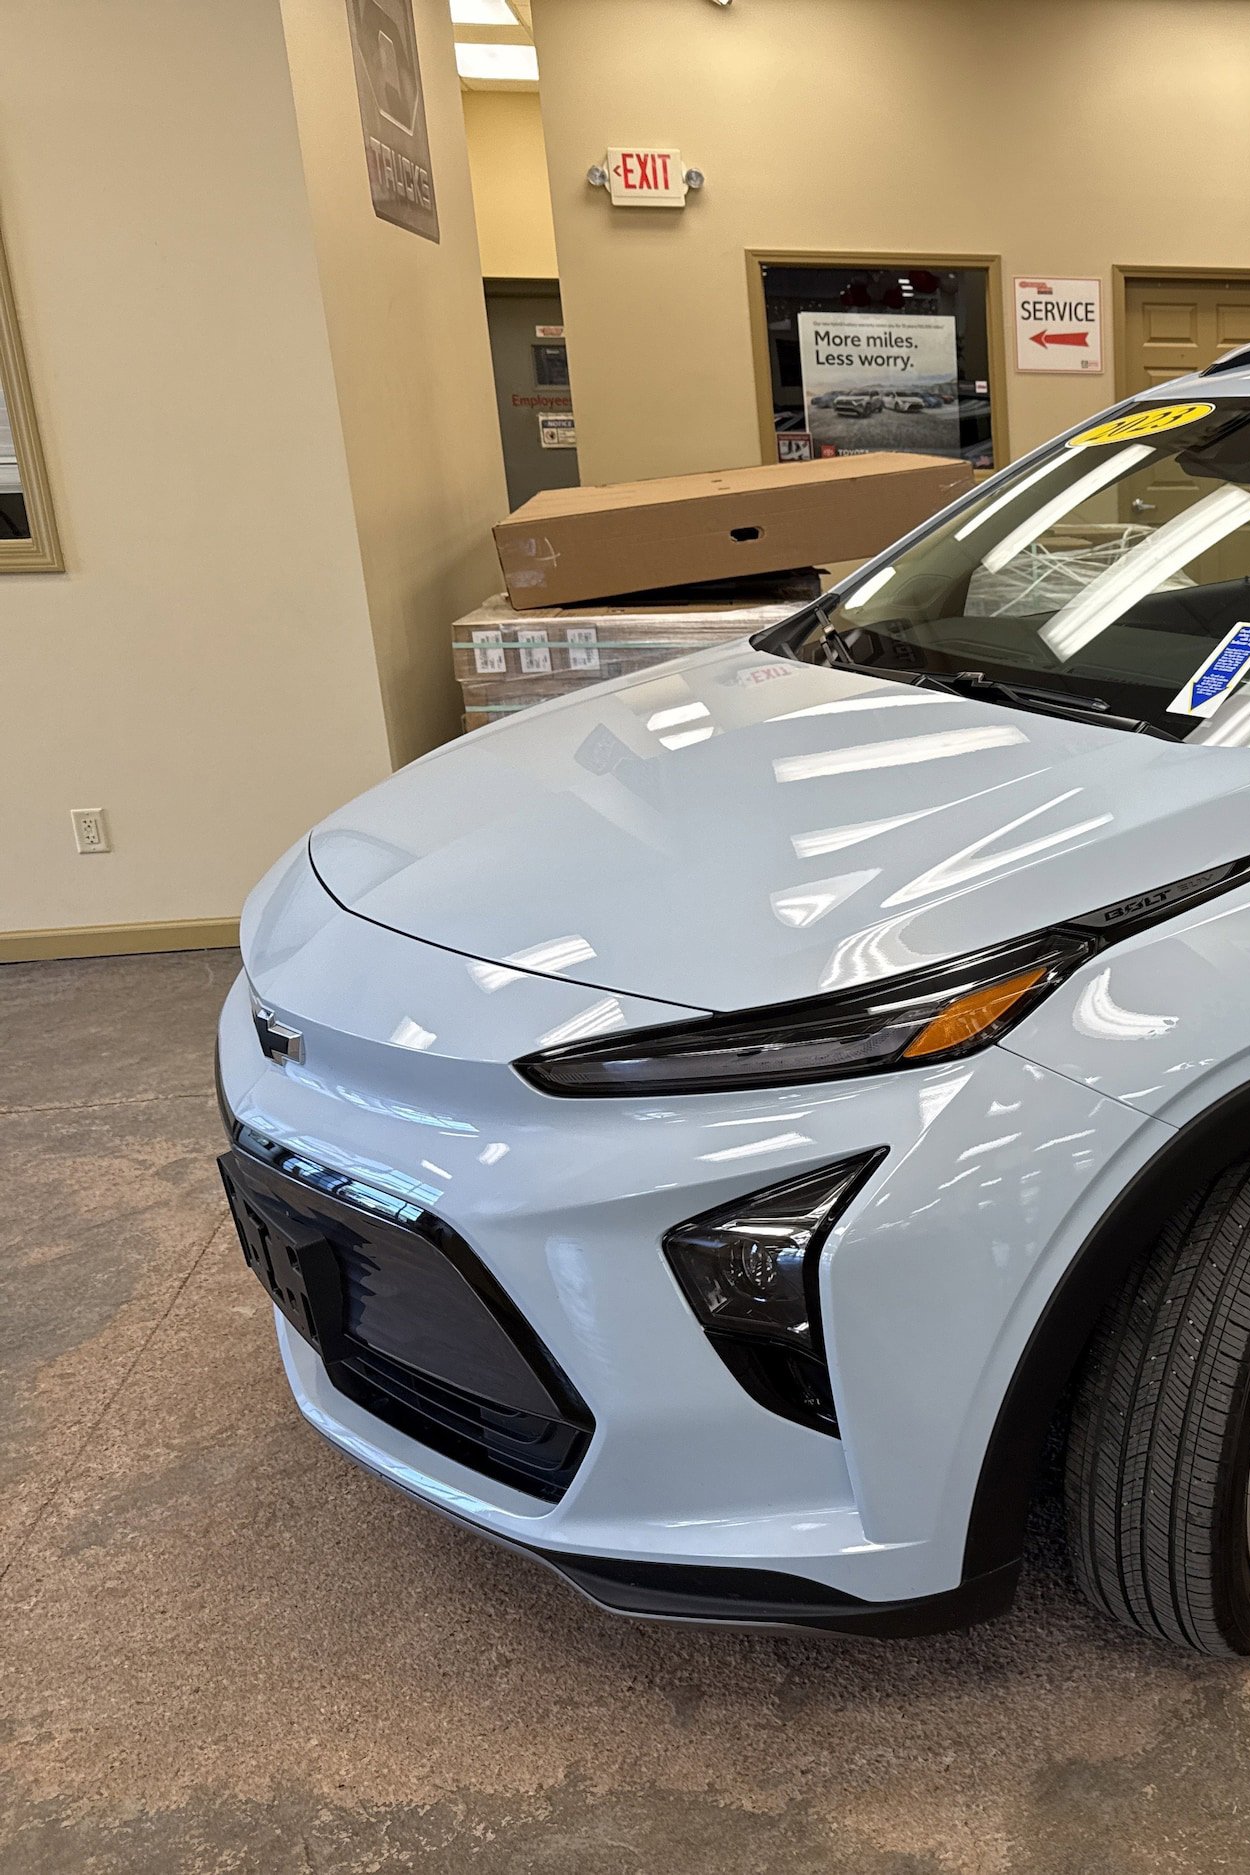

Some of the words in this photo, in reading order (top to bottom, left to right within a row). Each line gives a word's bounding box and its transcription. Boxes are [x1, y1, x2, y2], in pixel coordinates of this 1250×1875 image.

[370, 136, 431, 211] TRUCKS
[621, 153, 671, 190] EXIT
[1021, 300, 1095, 322] SERVICE
[814, 330, 861, 347] More
[866, 332, 918, 349] miles.
[815, 349, 854, 366] Less
[858, 354, 914, 371] worry.
[1086, 406, 1197, 442] 2023
[1104, 889, 1171, 921] BOLT
